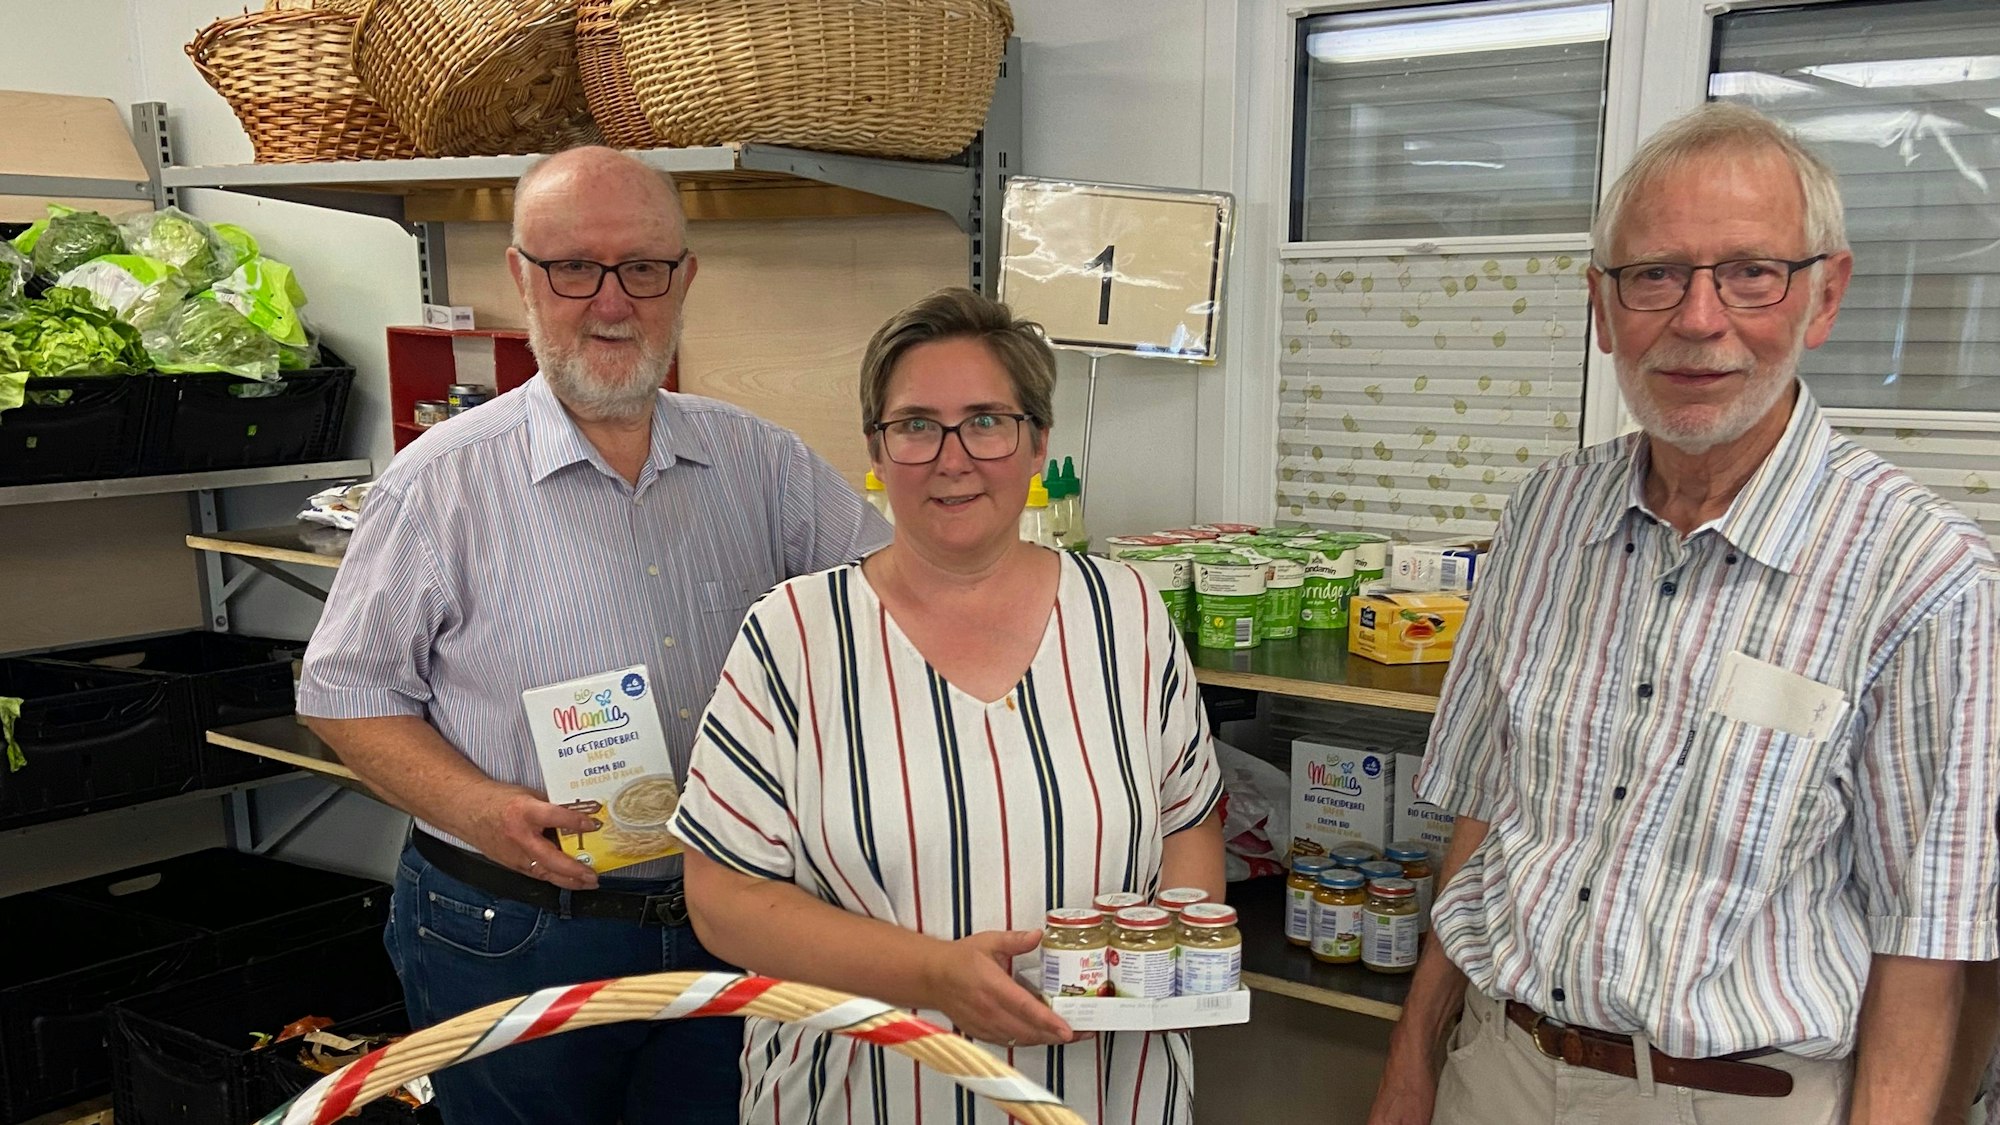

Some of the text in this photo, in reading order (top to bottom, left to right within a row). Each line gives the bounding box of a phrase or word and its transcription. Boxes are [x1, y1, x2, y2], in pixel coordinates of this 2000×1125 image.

[1084, 244, 1115, 325] 1
[1305, 565, 1337, 576] ondamin
[1301, 581, 1344, 603] orridge
[574, 688, 592, 702] bio
[553, 705, 630, 735] Mamia
[557, 730, 640, 759] BIO GETREIDEBREI
[583, 760, 626, 777] CREMA BIO
[1307, 760, 1362, 791] Mamia
[1304, 793, 1316, 803] BIO
